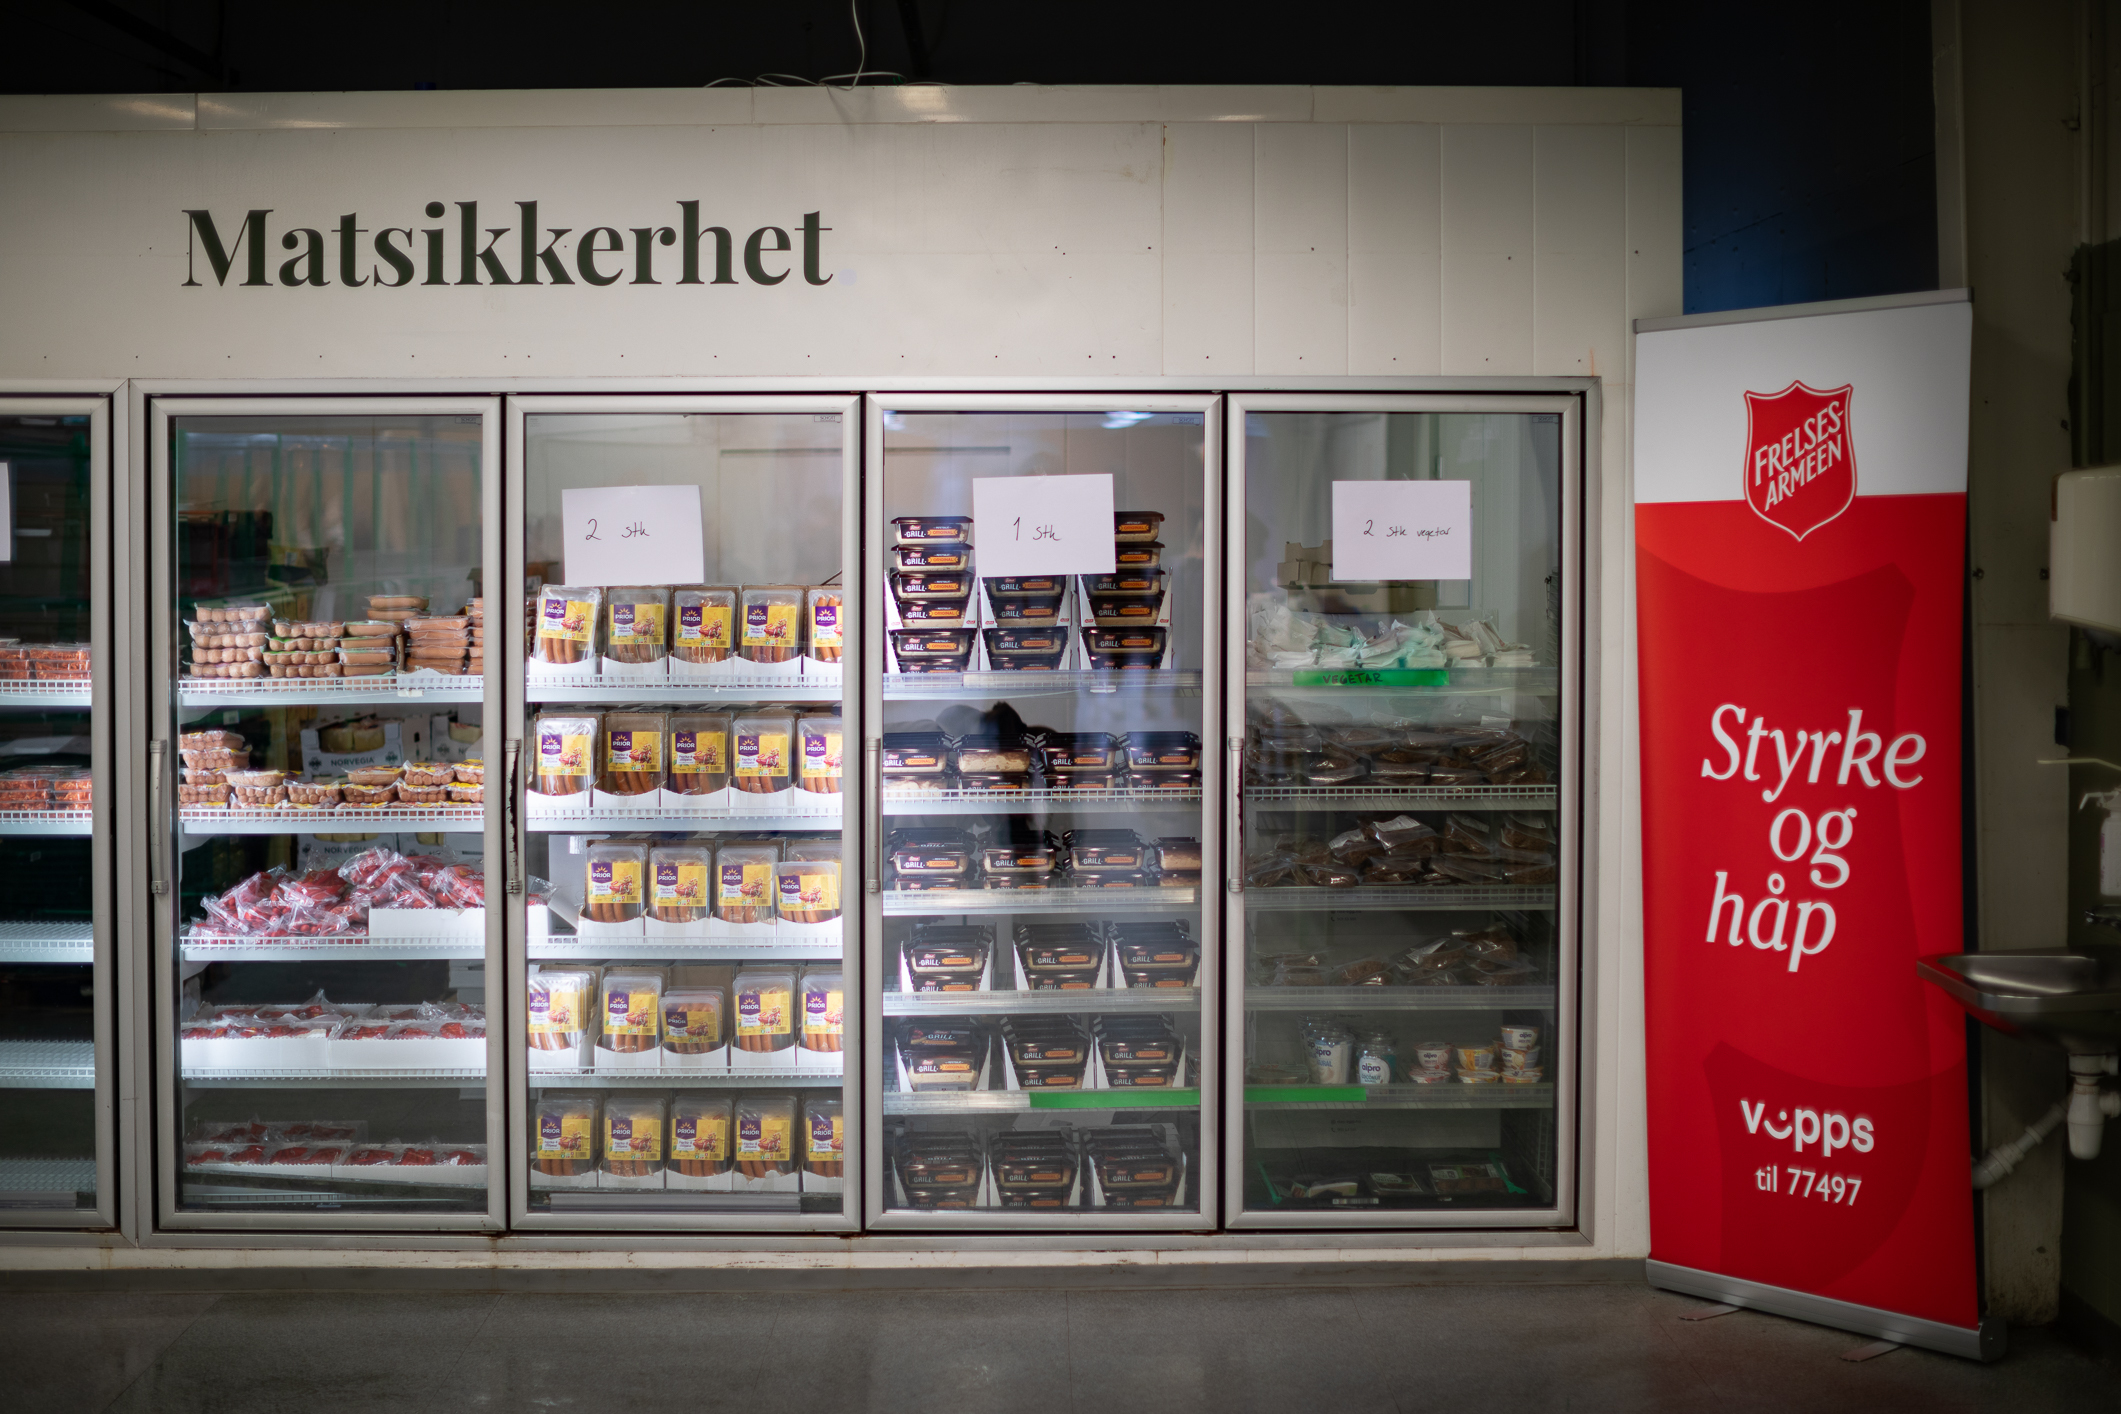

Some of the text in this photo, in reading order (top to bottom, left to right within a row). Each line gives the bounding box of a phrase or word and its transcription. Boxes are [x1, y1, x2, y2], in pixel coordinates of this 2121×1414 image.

[180, 200, 833, 287] Matsikkerhet
[1755, 400, 1844, 487] FRELSES-
[1764, 434, 1842, 512] ARMEEN
[586, 518, 602, 540] 2
[1014, 516, 1020, 541] 1
[1364, 520, 1374, 536] 2
[1322, 673, 1384, 684] VEGETAR
[330, 756, 374, 766] NORVEGIA
[1701, 703, 1927, 803] Styrke
[1770, 808, 1858, 889] og
[1706, 871, 1837, 972] håp
[1362, 1063, 1381, 1073] alpro
[1755, 1165, 1862, 1206] til 77497
